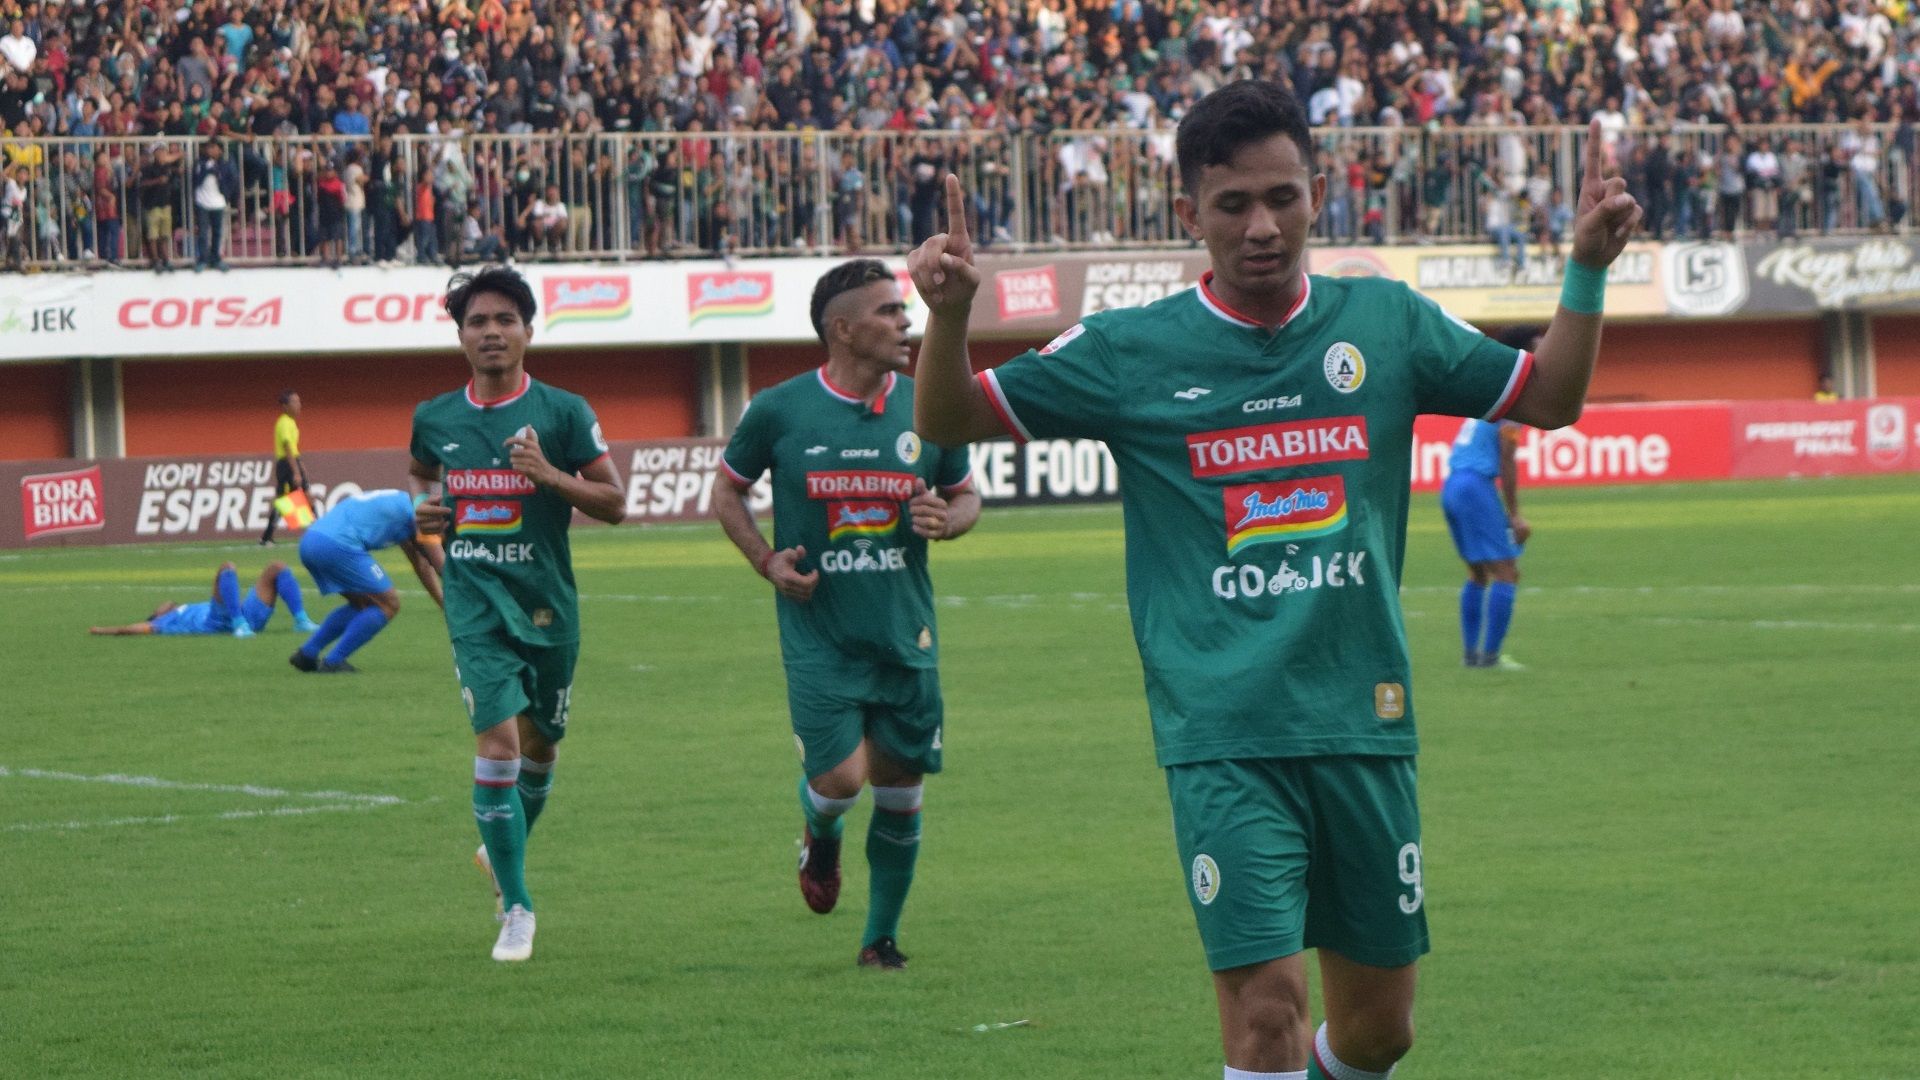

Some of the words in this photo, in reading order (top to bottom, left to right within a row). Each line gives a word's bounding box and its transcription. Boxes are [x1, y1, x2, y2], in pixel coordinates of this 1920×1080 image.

[31, 306, 76, 333] JEK
[631, 448, 685, 471] KOPI
[1188, 425, 1369, 468] TORABIKA
[144, 463, 203, 488] KOPI
[206, 460, 273, 485] SUSU
[807, 476, 913, 494] TORABIKA
[27, 478, 96, 505] TORA
[33, 501, 97, 528] BIKA
[1398, 842, 1424, 914] 9
